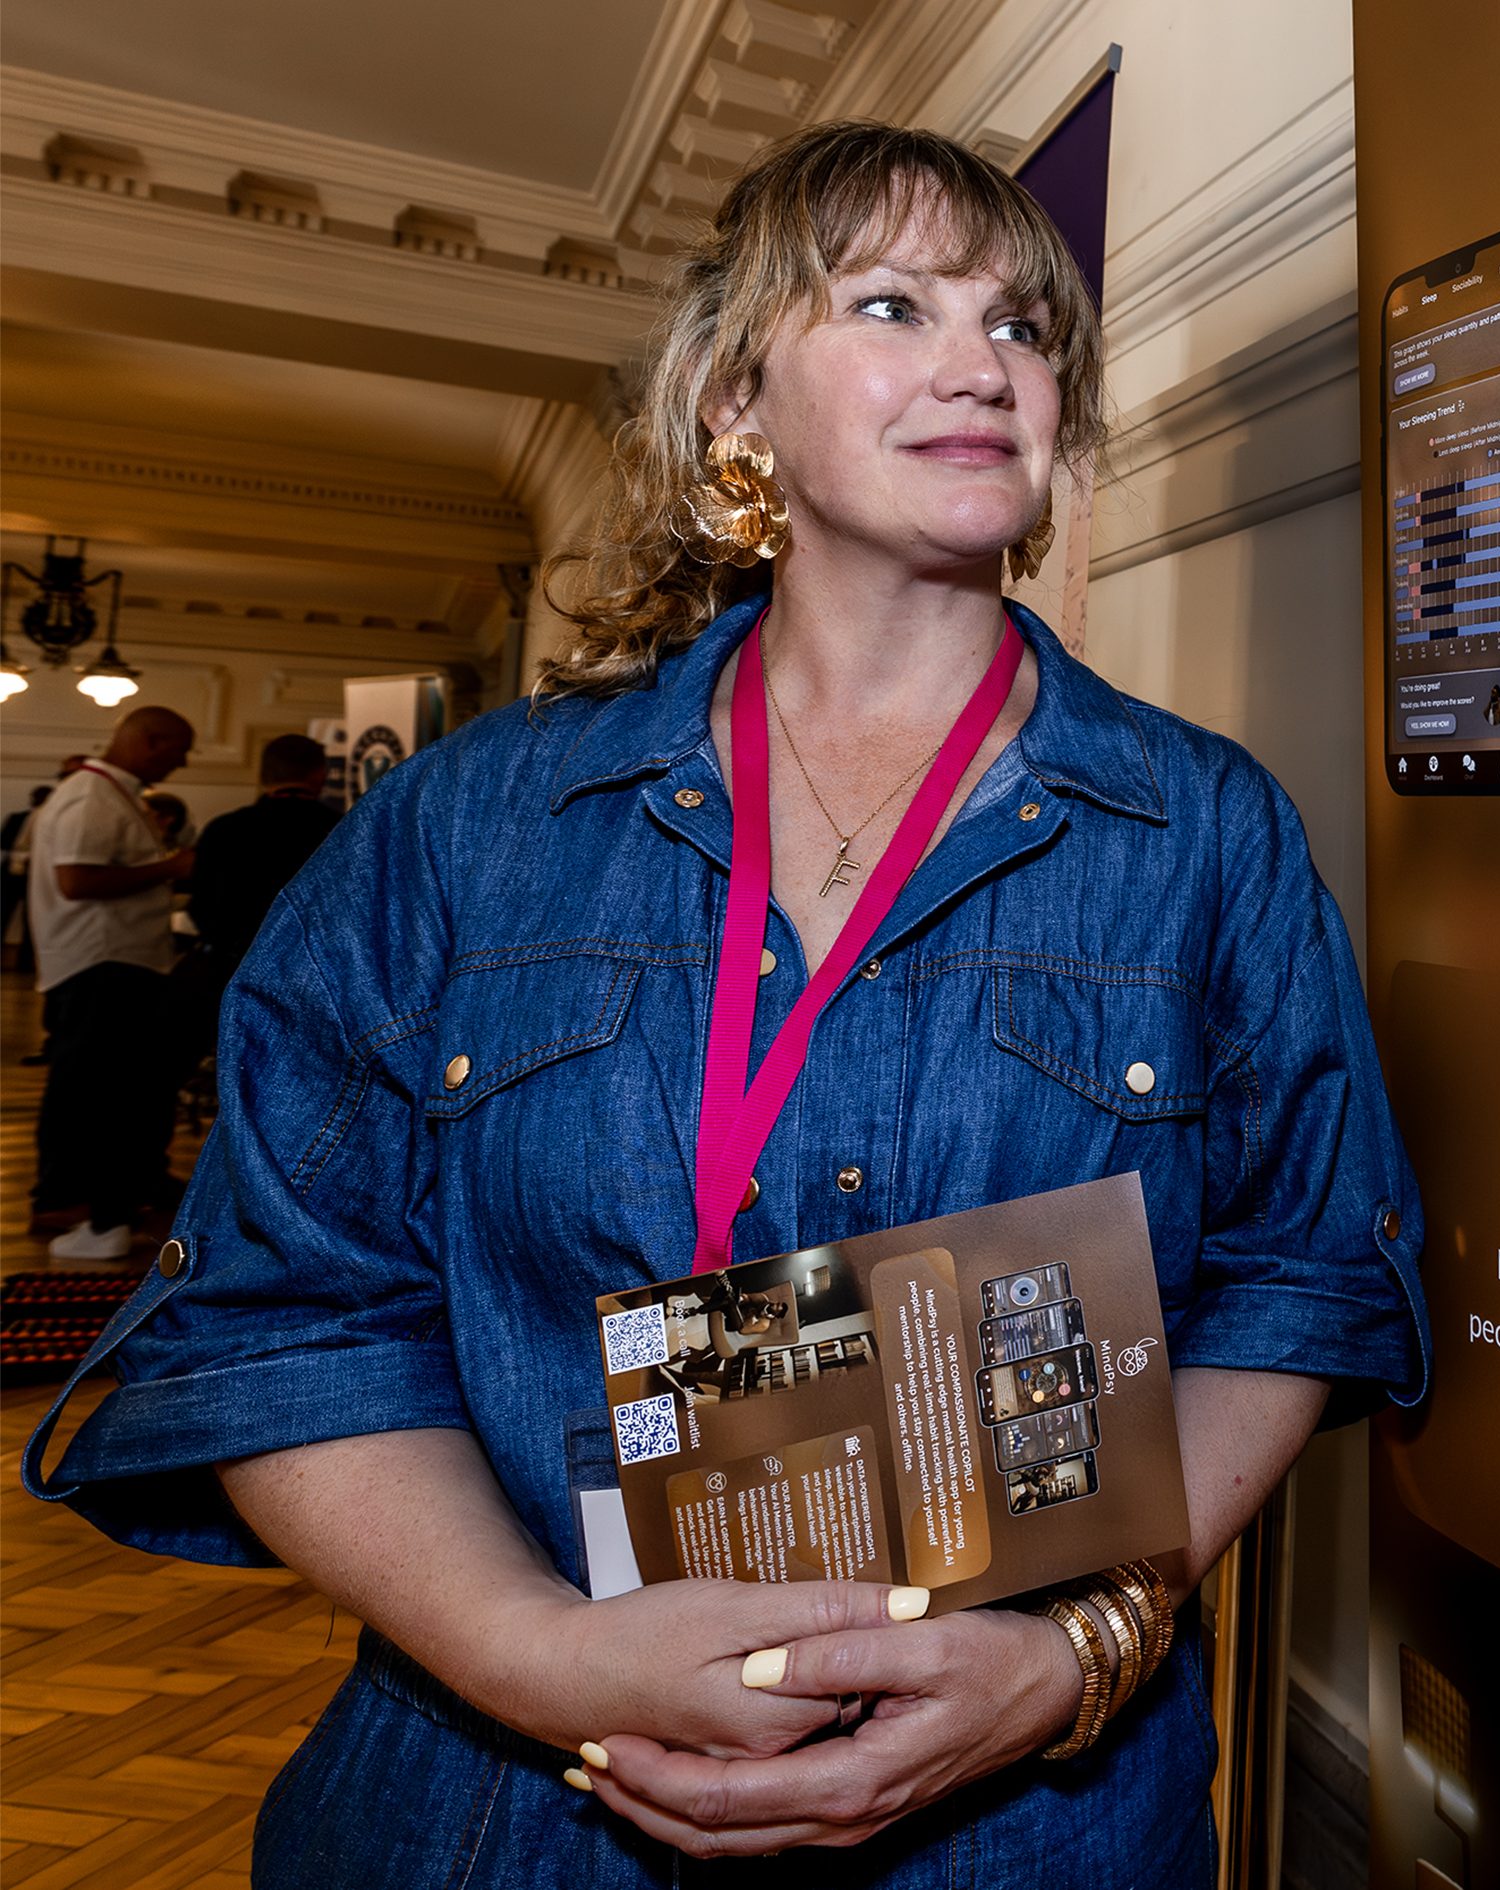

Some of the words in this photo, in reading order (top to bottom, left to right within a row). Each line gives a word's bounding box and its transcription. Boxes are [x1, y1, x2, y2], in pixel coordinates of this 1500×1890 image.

[945, 1333, 958, 1363] YOUR
[1101, 1339, 1116, 1396] MindPsy
[684, 1386, 695, 1408] Join
[950, 1363, 969, 1448] COMPASSIONATE
[686, 1409, 701, 1450] waitlist
[961, 1449, 975, 1493] COPILOT
[856, 1459, 871, 1522] DATA-POWERED
[864, 1522, 876, 1561] INSIGHTS
